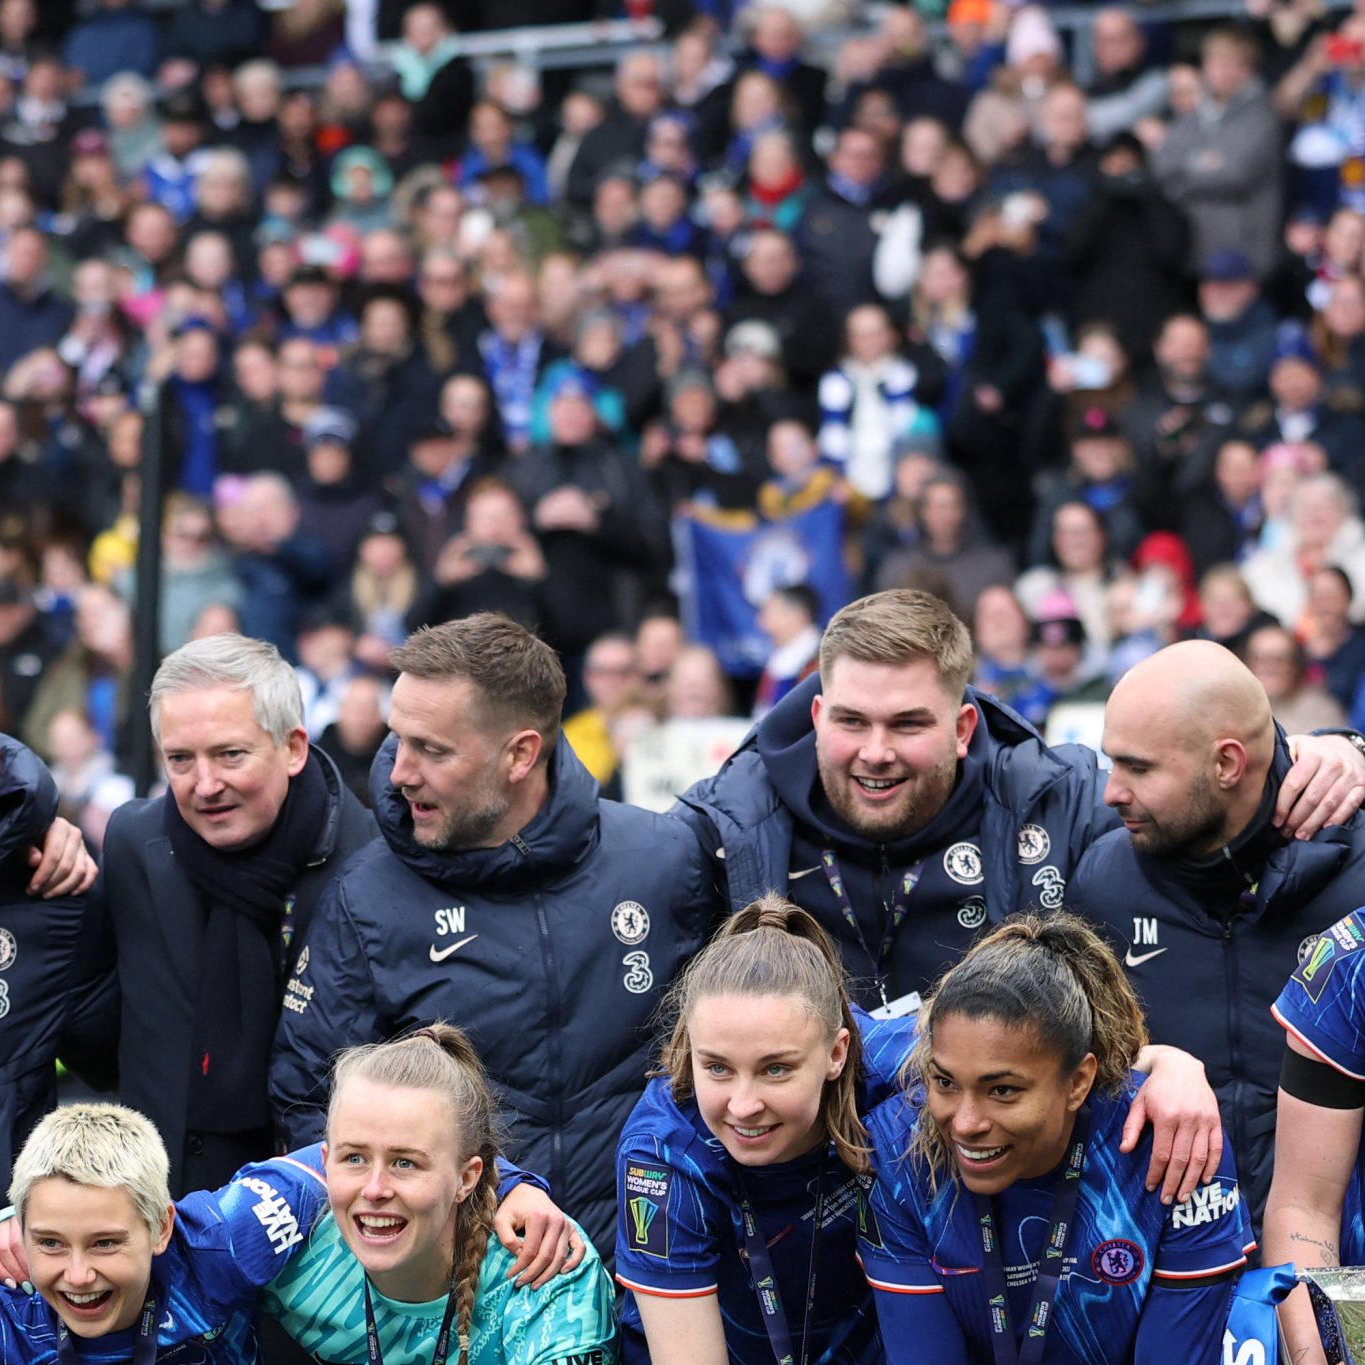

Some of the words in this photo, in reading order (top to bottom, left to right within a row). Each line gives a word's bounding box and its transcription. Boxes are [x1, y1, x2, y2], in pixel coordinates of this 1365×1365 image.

[435, 905, 466, 936] SW
[1133, 917, 1158, 945] JM
[626, 1175, 668, 1191] WOMEN'S
[628, 1167, 667, 1181] SUBWAY
[626, 1184, 649, 1195] LEAGUE
[649, 1187, 666, 1197] CUP
[240, 1176, 304, 1245] NATION
[251, 1203, 290, 1255] LIVE
[1099, 1240, 1131, 1253] CHELSEA
